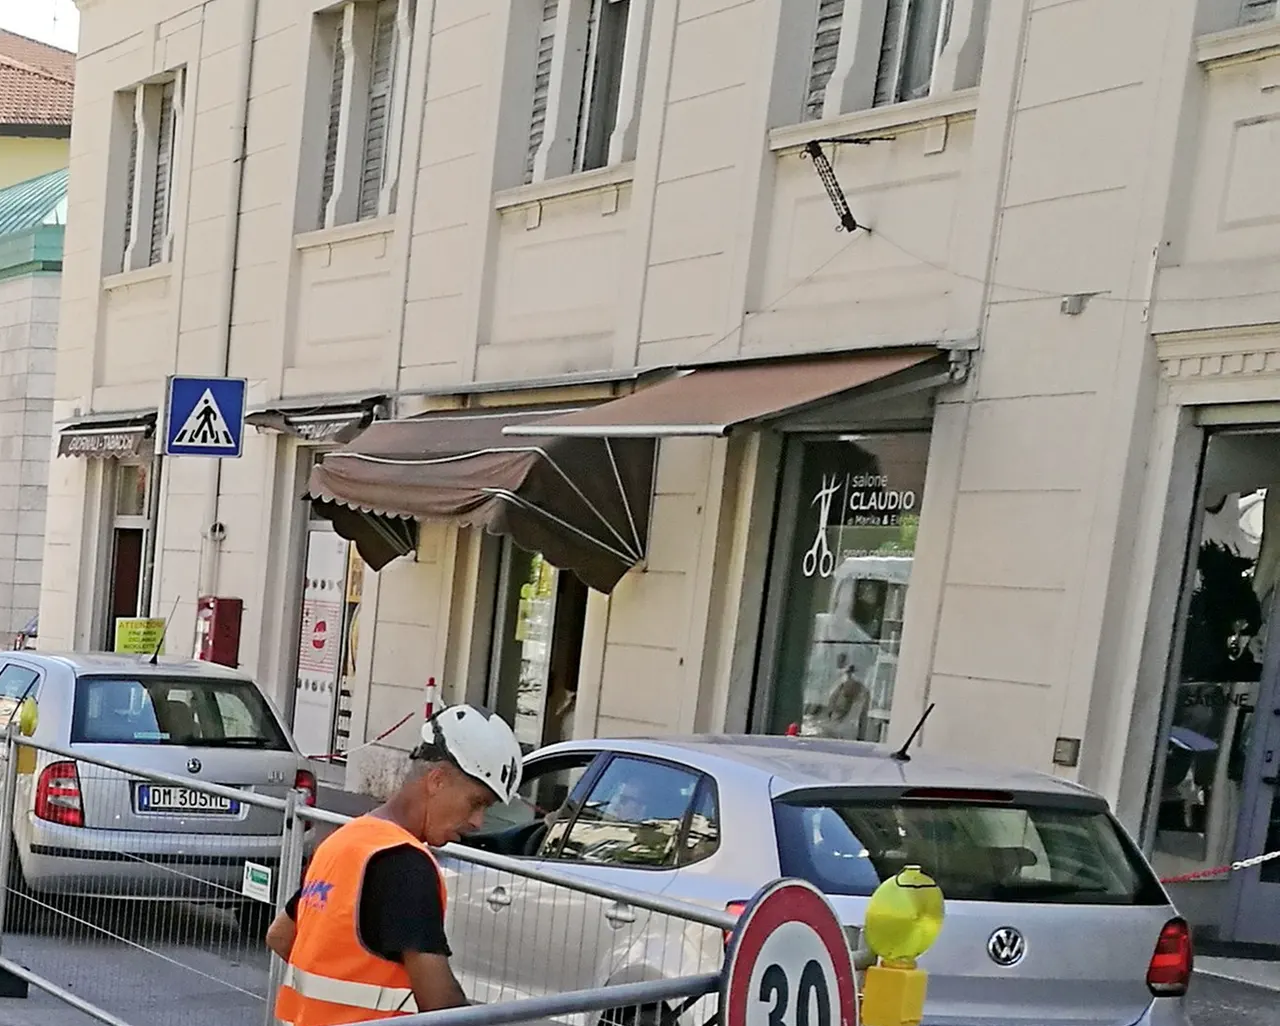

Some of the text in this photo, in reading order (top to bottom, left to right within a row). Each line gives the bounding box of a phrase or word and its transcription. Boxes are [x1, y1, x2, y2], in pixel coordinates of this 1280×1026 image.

[852, 472, 889, 488] salone
[850, 490, 915, 511] CLAUDIO
[151, 788, 172, 805] DM
